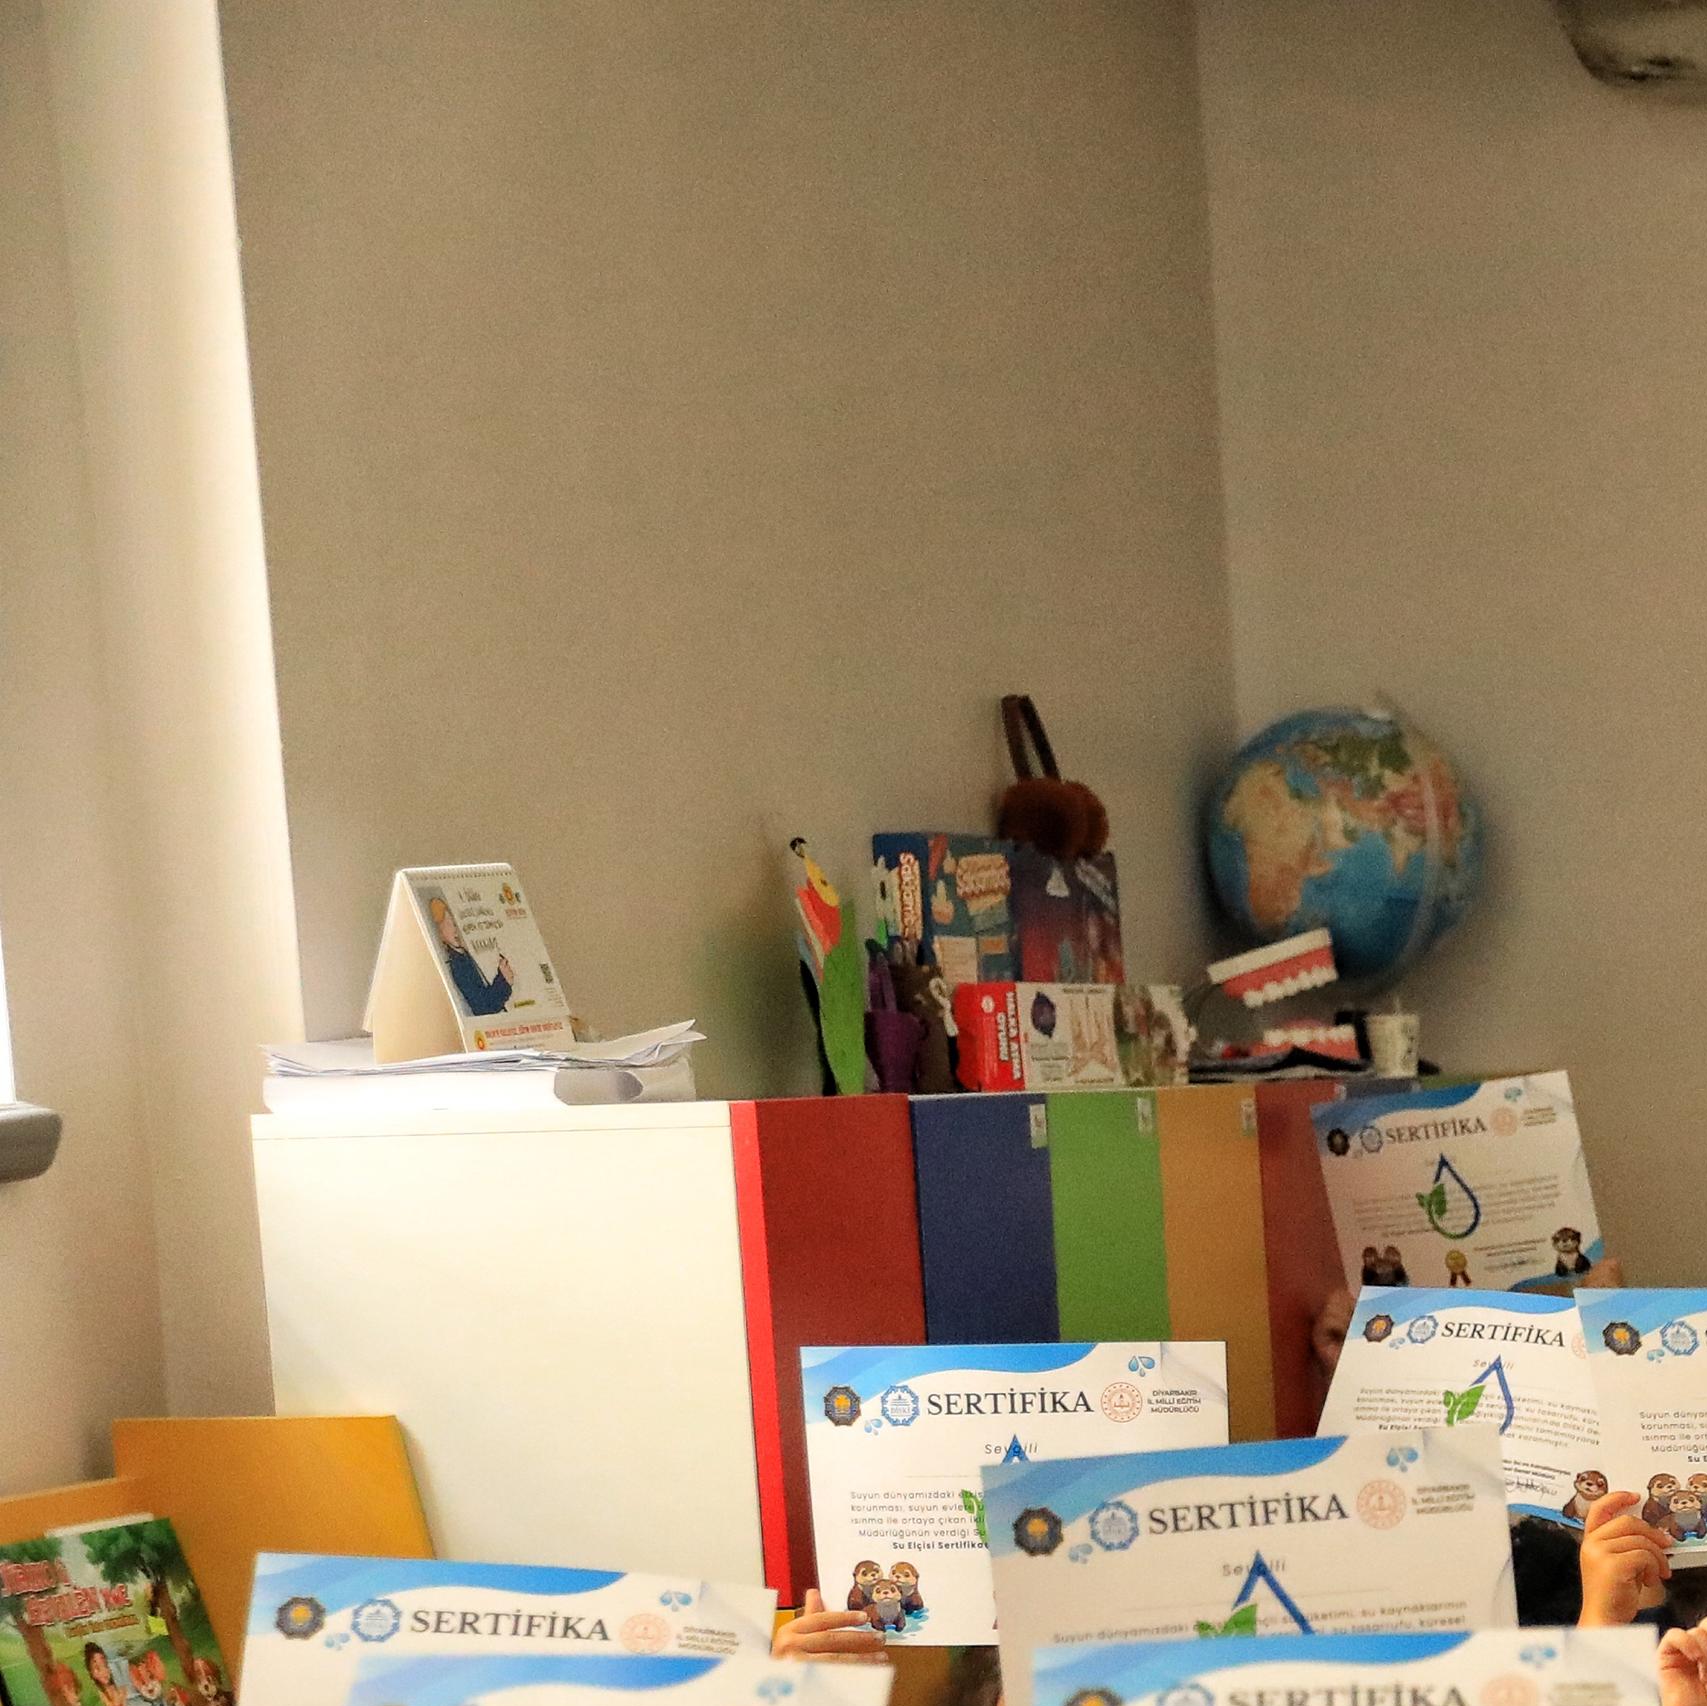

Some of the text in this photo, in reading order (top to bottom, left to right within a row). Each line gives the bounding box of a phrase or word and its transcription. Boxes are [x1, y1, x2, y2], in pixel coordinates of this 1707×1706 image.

[1441, 1319, 1566, 1346] SERTİFİKA
[927, 1390, 1094, 1414] SERTİFİKA
[1147, 1490, 1349, 1535] SERTİFİKA
[409, 1608, 611, 1642] SERTİFİKA
